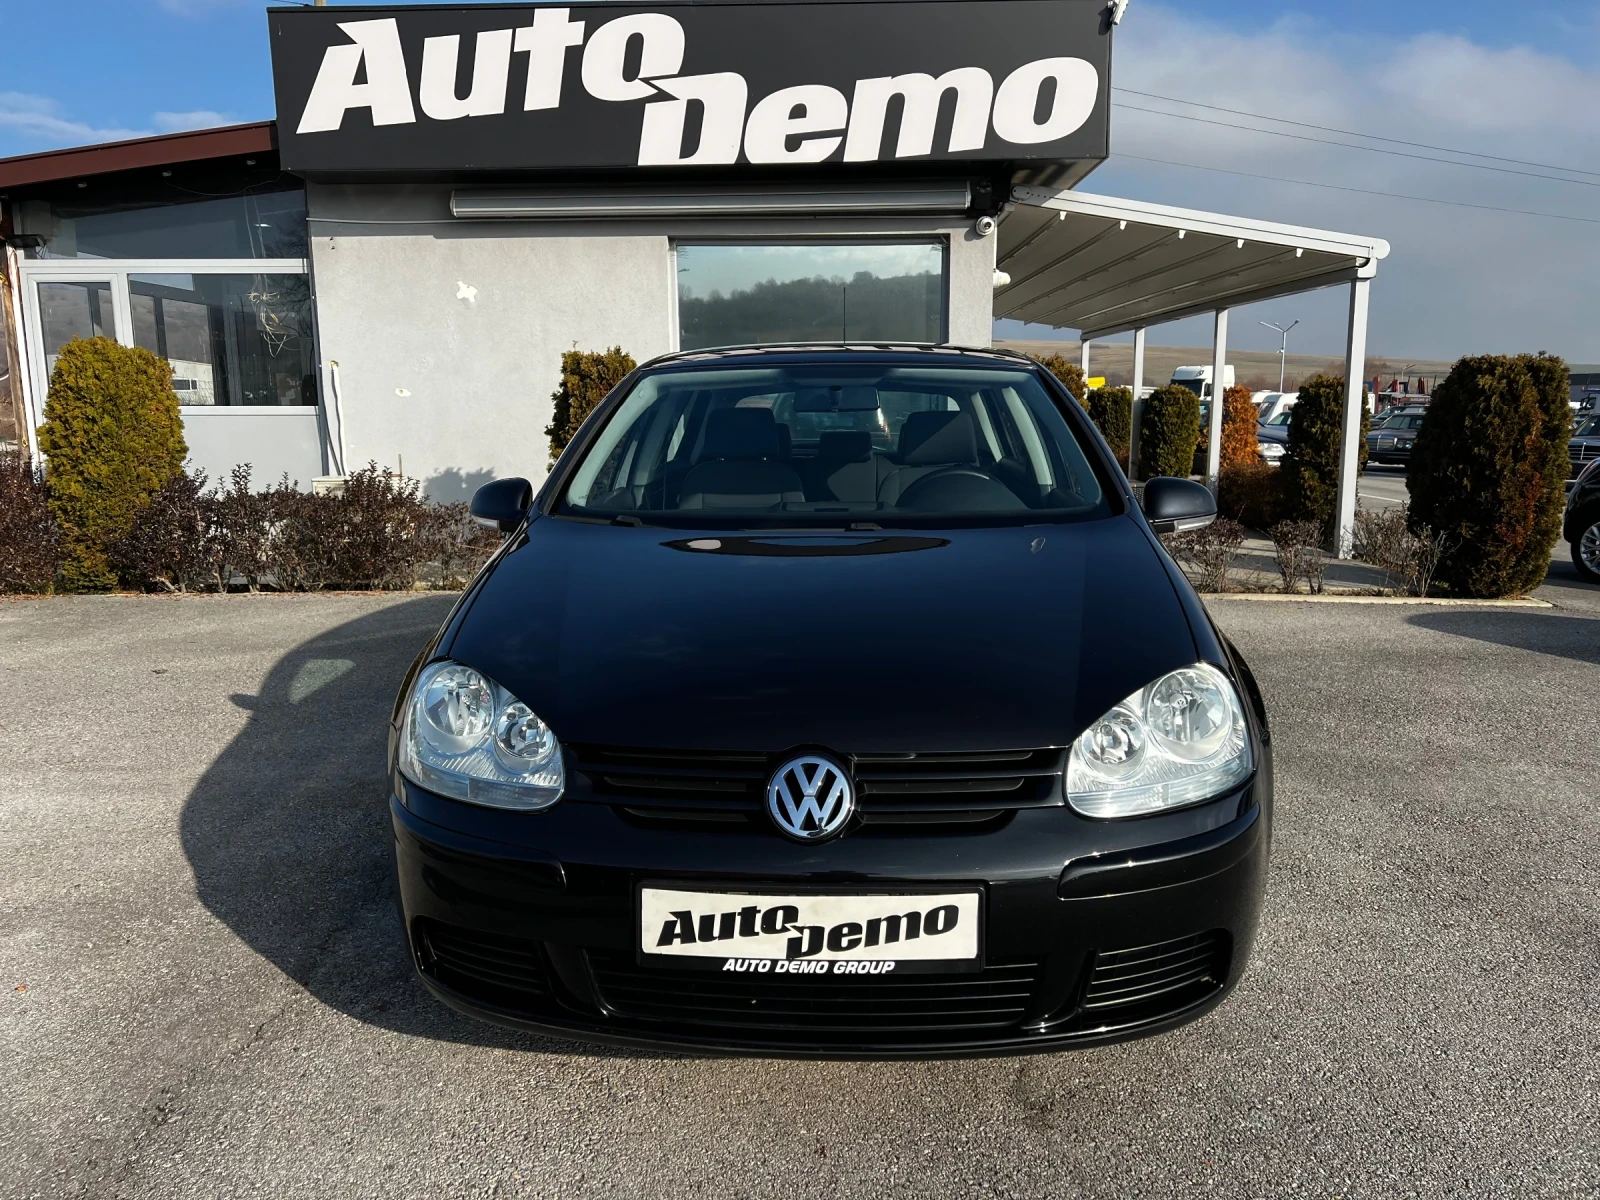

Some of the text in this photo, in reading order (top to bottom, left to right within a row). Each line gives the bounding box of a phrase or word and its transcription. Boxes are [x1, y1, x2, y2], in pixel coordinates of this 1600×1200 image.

[296, 8, 1099, 166] Auto Demo
[769, 756, 850, 837] VW
[656, 904, 959, 959] Auto Demo
[723, 959, 895, 974] AUTO DEMO GROUP
